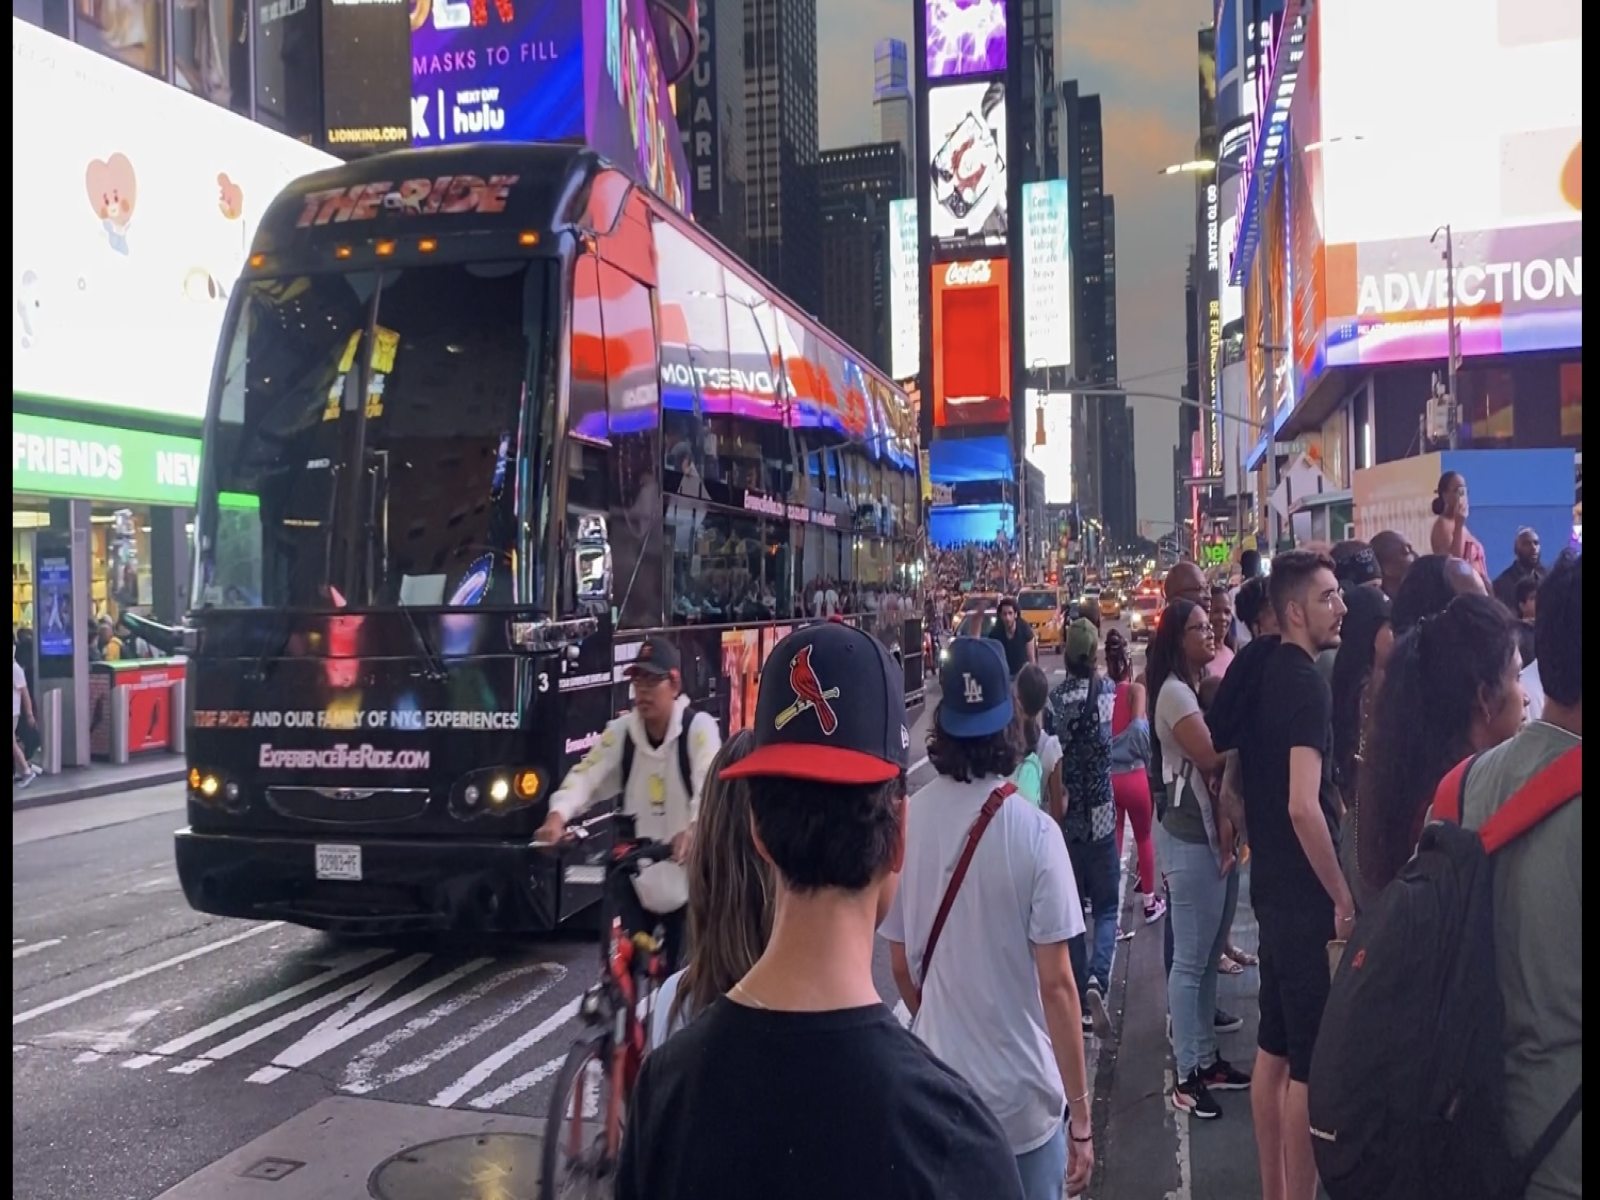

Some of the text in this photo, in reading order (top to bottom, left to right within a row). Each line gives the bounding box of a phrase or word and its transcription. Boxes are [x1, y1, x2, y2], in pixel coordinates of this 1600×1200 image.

[413, 42, 558, 75] MASKS TO FILL
[457, 87, 500, 105] NEXT DAY
[694, 0, 712, 190] QUARE
[327, 127, 408, 143] LIONKING.COM
[453, 104, 505, 135] hulu
[296, 174, 520, 228] THE RIDE
[1356, 256, 1583, 315] ADVECTION
[1209, 300, 1219, 317] BE
[13, 432, 123, 481] FRIENDS
[538, 672, 549, 693] 3
[962, 672, 984, 703] LA
[252, 711, 281, 727] AND
[284, 710, 314, 727] OUR
[317, 711, 365, 729] FAMILY
[368, 710, 388, 727] OF
[391, 710, 422, 728] NYC
[425, 711, 519, 729] EXPERIENCES
